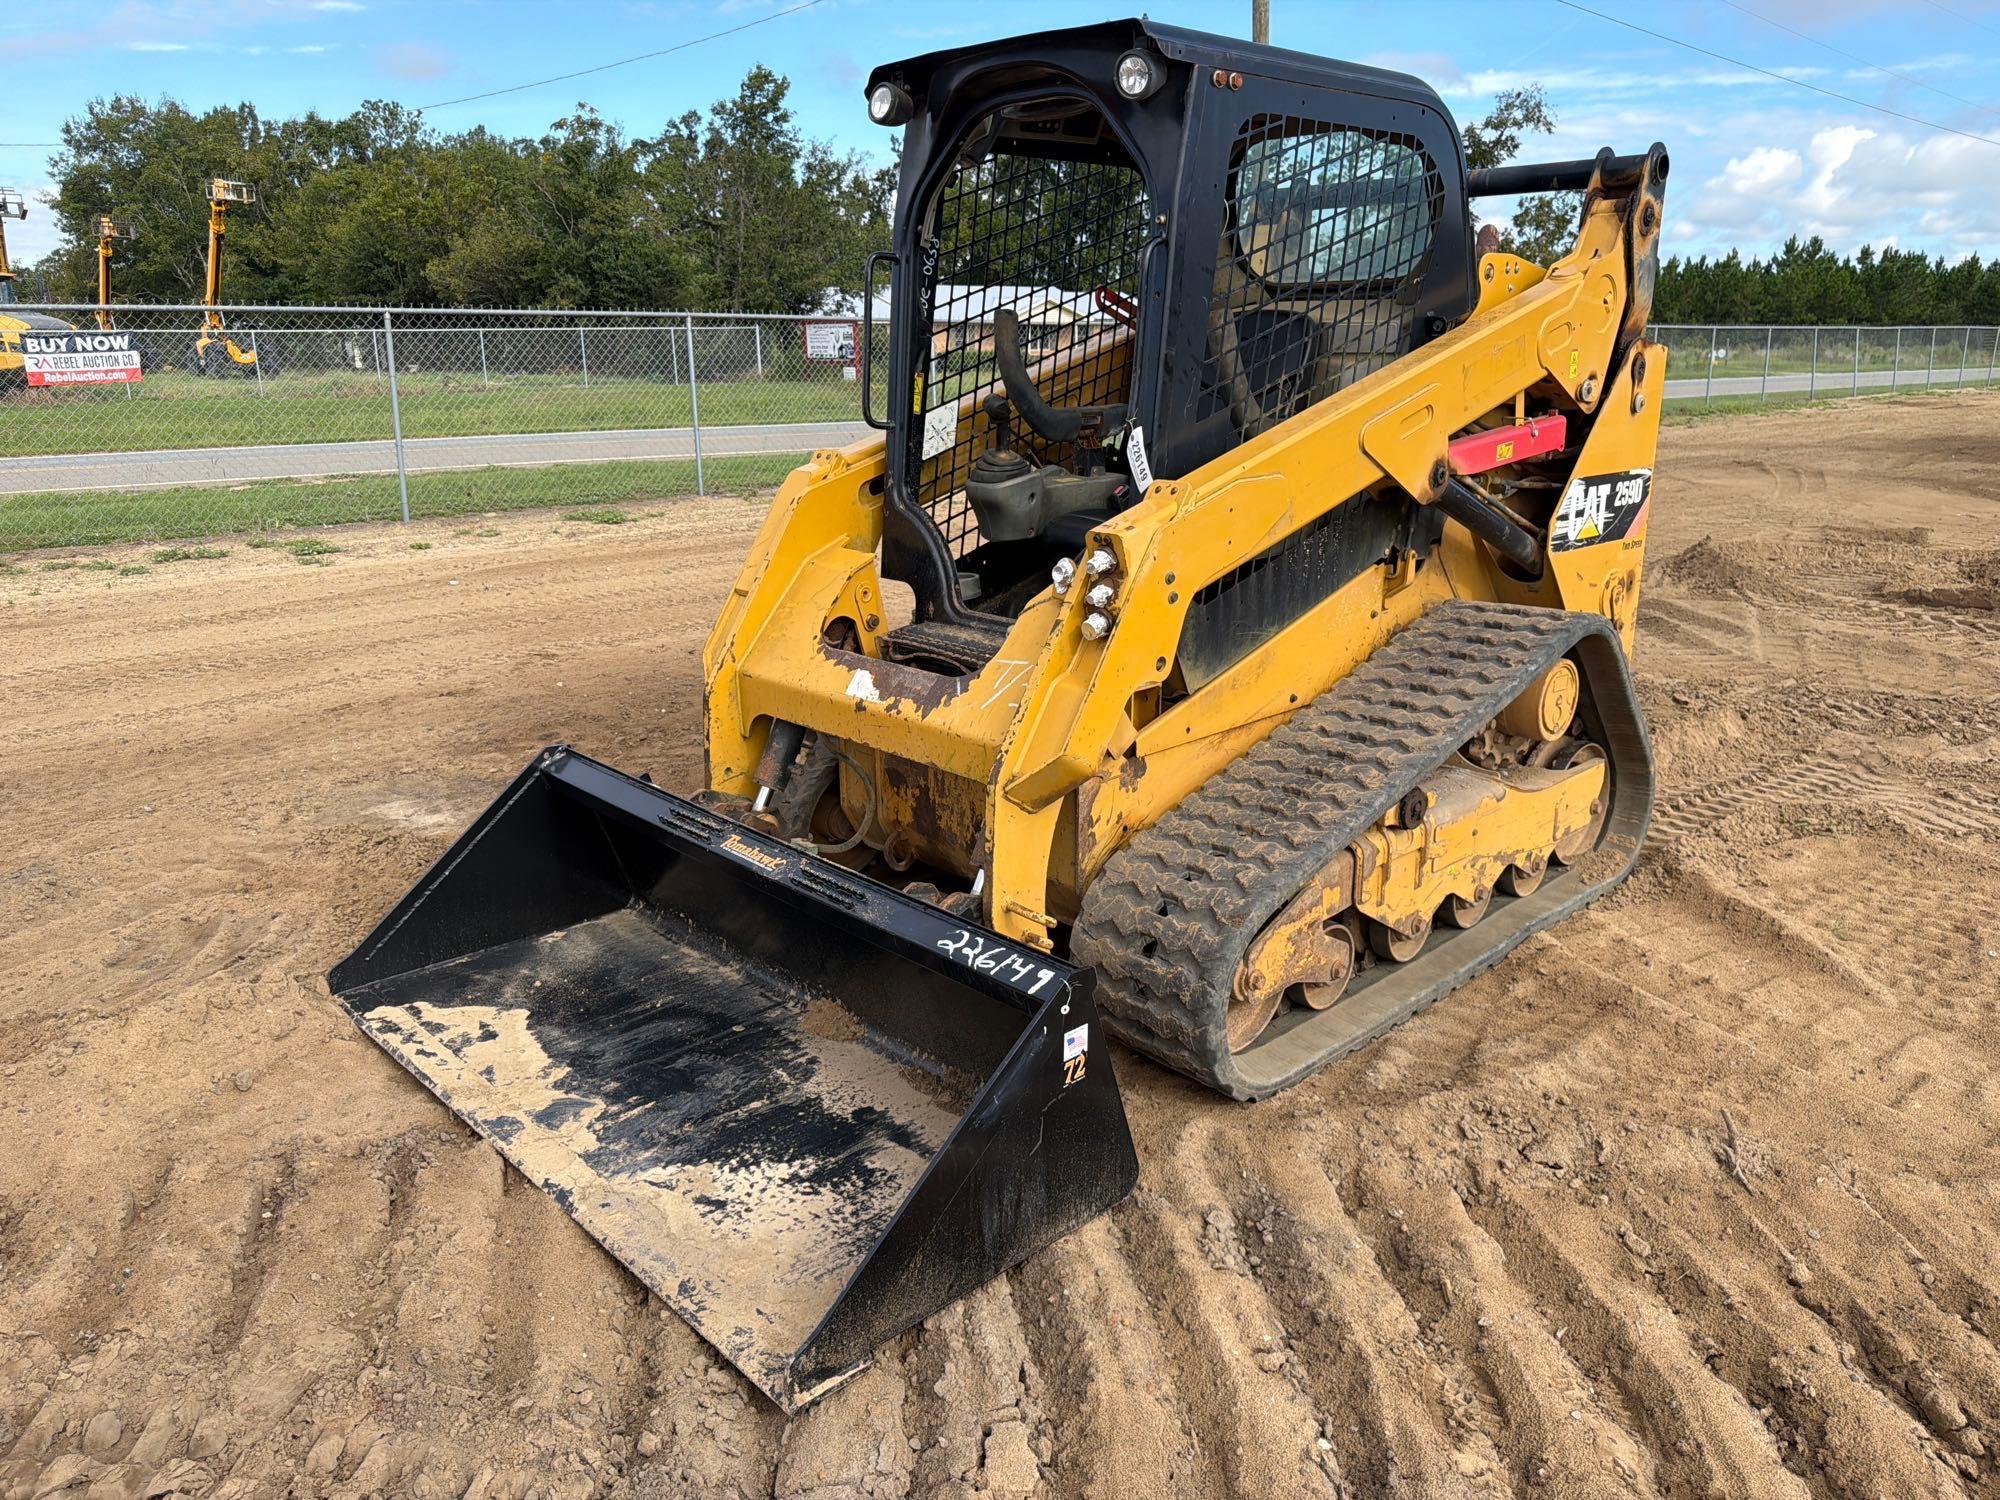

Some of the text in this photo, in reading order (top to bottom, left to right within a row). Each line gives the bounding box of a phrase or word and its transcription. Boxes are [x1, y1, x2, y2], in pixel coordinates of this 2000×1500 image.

[26, 335, 129, 353] BUY NOW
[44, 371, 127, 383] RebelAuction.com
[53, 354, 138, 370] REBEL AUCTION CO.
[1131, 440, 1148, 482] 226149
[1566, 478, 1644, 541] CAT 259D
[719, 834, 787, 870] Tomahawk
[937, 928, 1056, 995] 226149
[1063, 1053, 1086, 1085] 72
